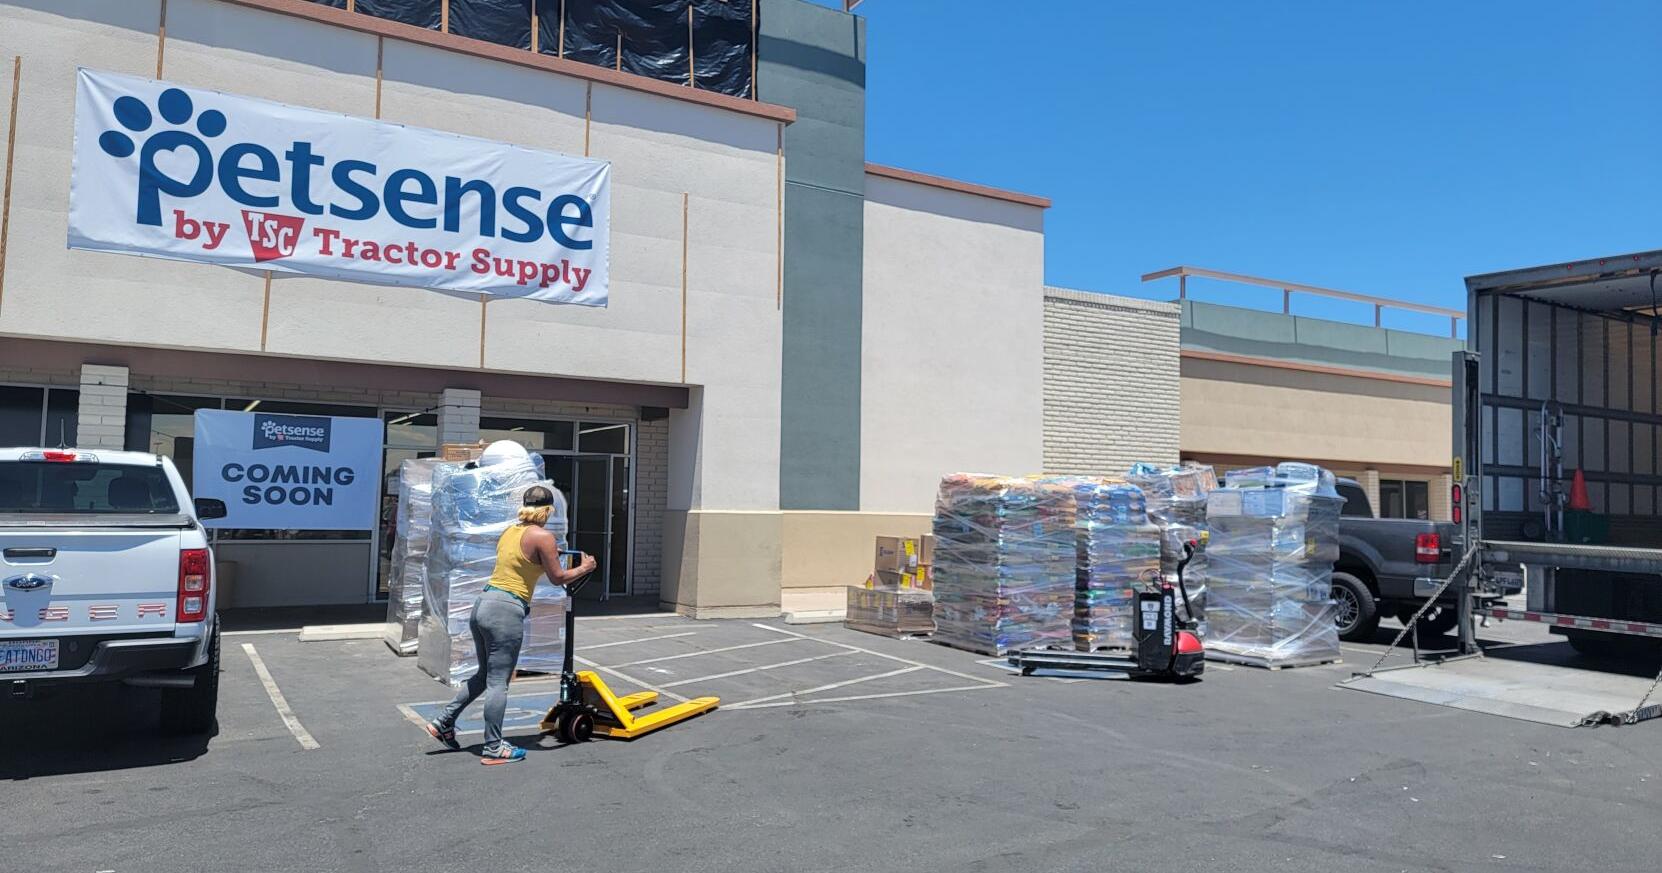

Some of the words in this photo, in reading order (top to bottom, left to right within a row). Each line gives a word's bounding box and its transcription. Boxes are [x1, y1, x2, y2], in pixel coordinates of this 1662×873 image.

[136, 130, 593, 250] petsense
[173, 209, 230, 250] by
[246, 211, 297, 255] TSC
[313, 227, 462, 271] Tractor
[471, 248, 592, 292] Supply
[265, 424, 325, 438] petsense
[221, 462, 355, 486] COMING
[242, 485, 333, 506] SOON
[1163, 595, 1172, 645] RAYMOND
